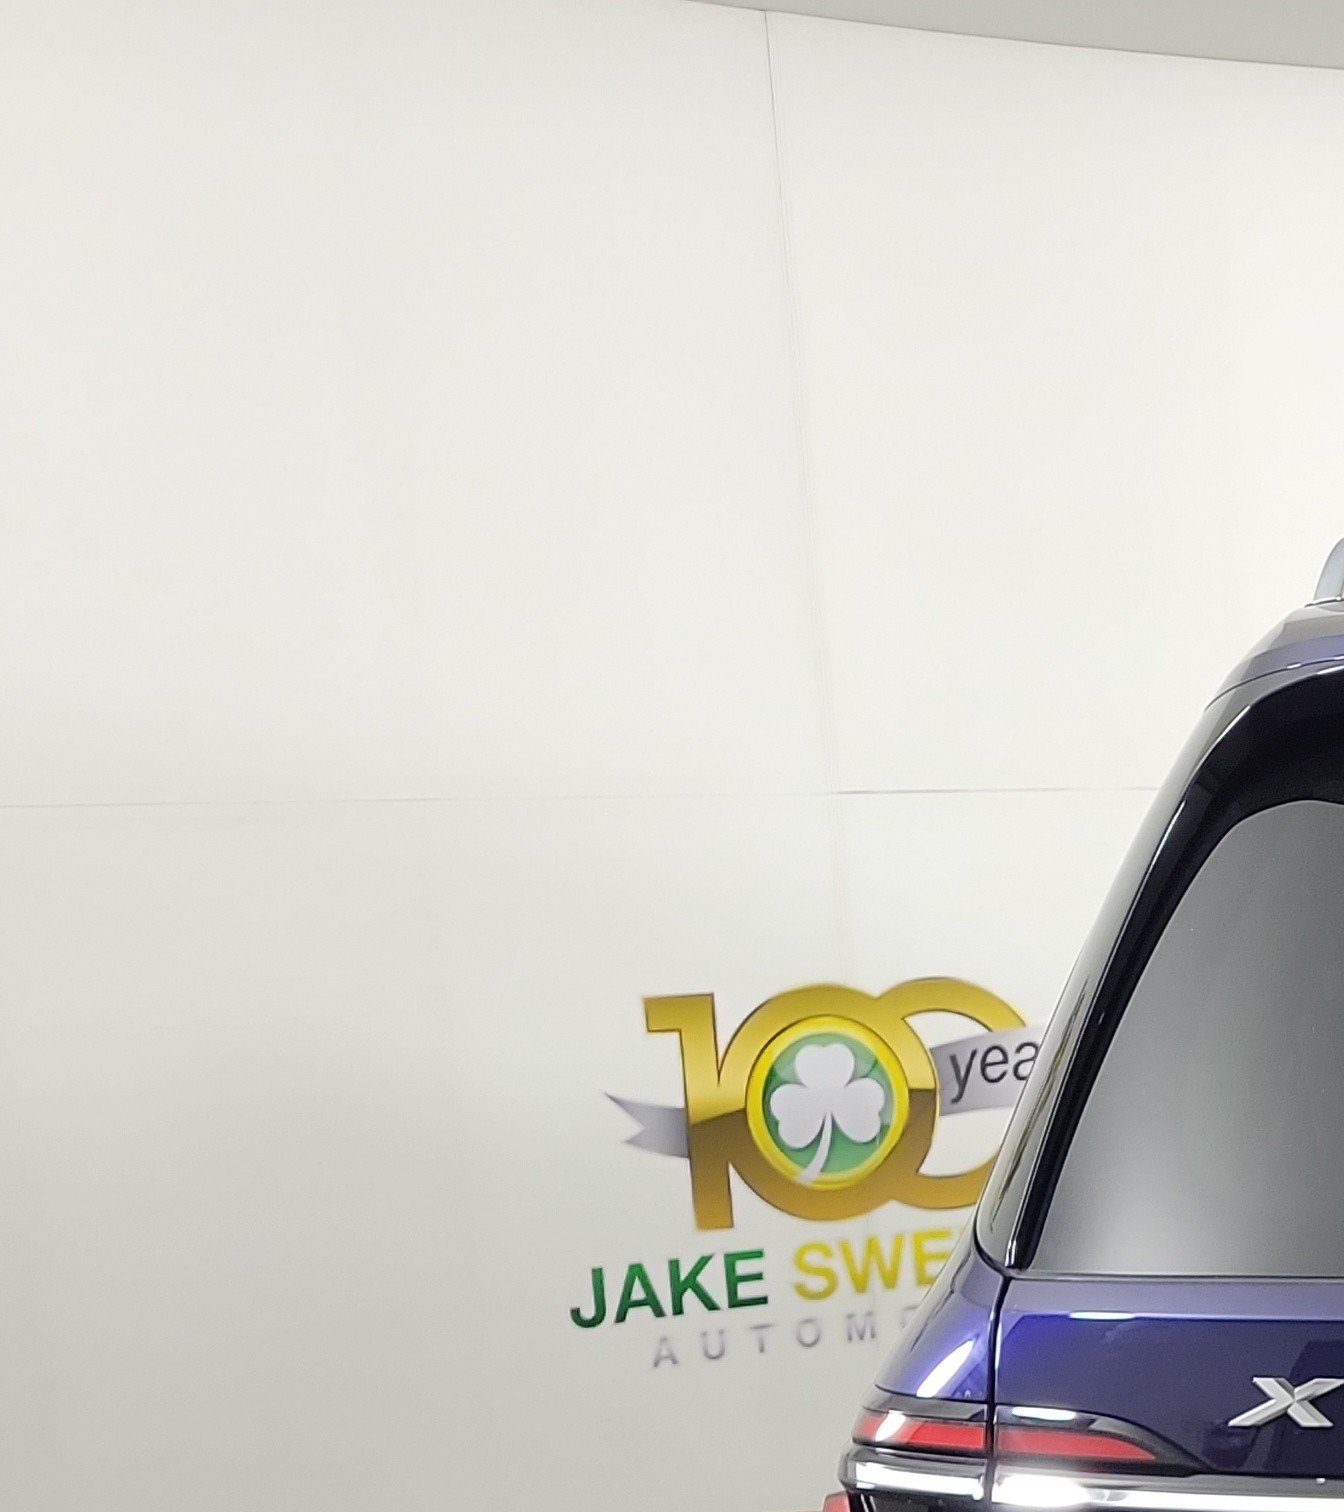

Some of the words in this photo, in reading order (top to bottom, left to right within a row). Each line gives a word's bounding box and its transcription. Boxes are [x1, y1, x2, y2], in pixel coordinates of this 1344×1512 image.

[569, 1248, 769, 1328] JAKE
[792, 1228, 962, 1301] SWE
[651, 1303, 919, 1369] AUTOM
